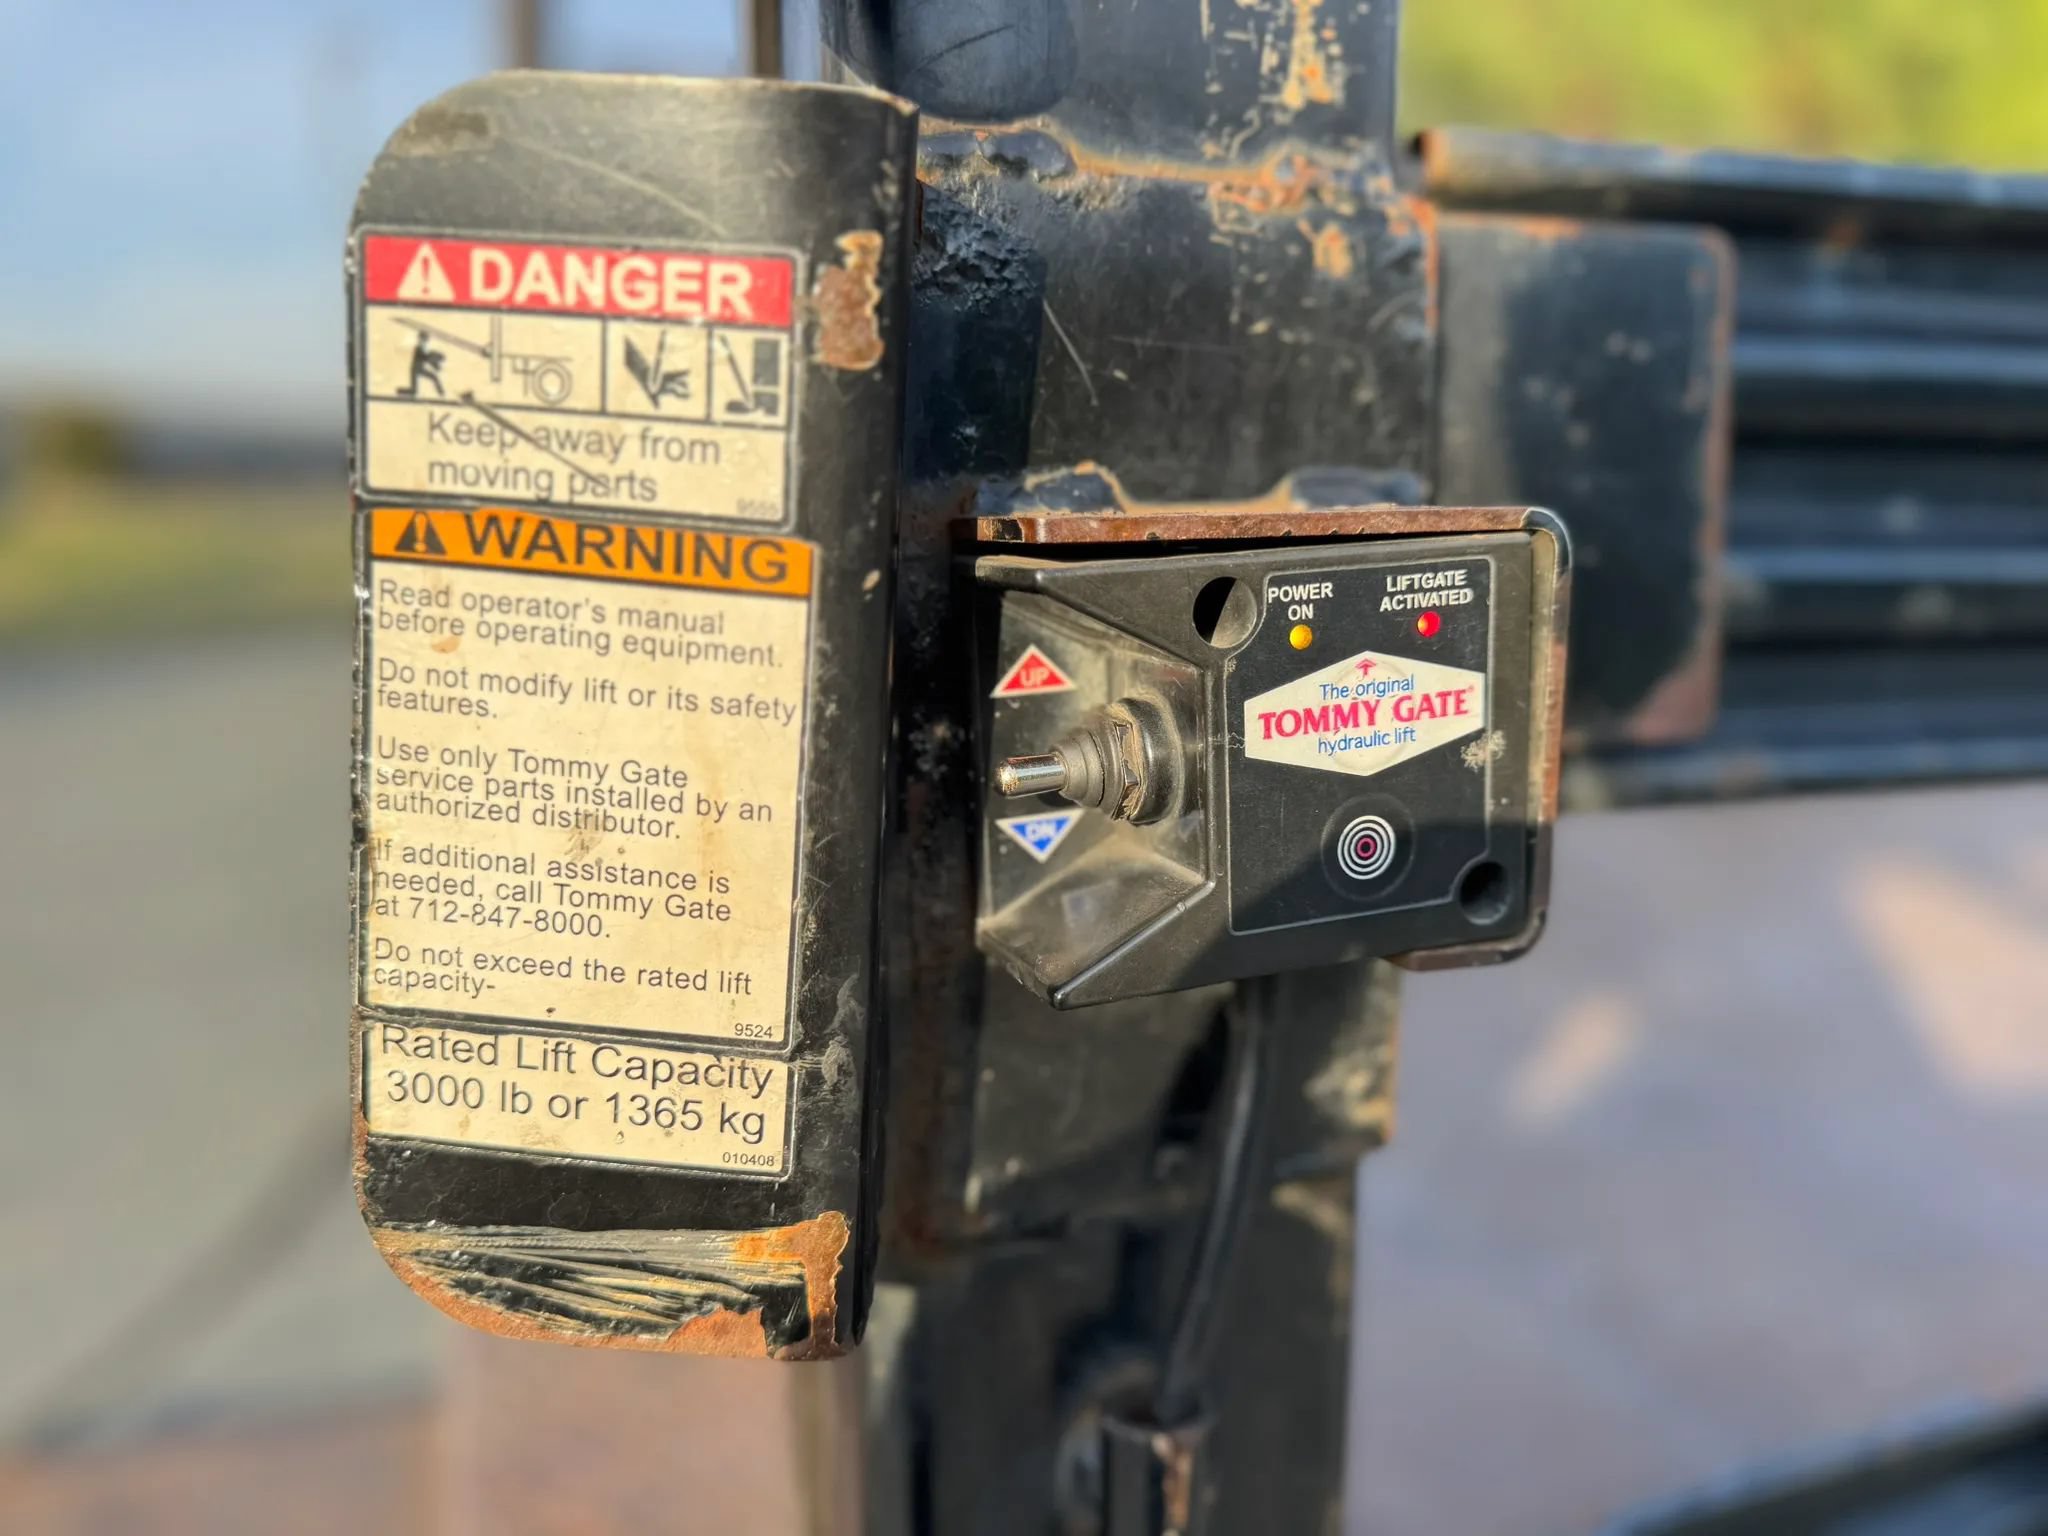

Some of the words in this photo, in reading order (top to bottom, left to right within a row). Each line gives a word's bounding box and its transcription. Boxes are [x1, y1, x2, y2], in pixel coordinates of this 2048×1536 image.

[470, 248, 754, 318] DANGER
[429, 412, 518, 454] Keep
[534, 427, 626, 463] away
[640, 429, 721, 464] from
[429, 459, 554, 500] moving
[569, 472, 658, 503] parts
[463, 511, 788, 584] WARNING
[1267, 581, 1334, 604] POWER
[1379, 587, 1474, 612] ACTIVATED
[1385, 569, 1469, 593] LIFTGATE
[380, 579, 450, 609] Read
[462, 592, 607, 625] operator's
[618, 606, 725, 635] manual
[1288, 603, 1315, 621] ON
[379, 608, 465, 636] before
[476, 616, 611, 656] operating
[623, 633, 783, 669] equipment.
[379, 658, 415, 684] Do
[426, 666, 469, 689] not
[480, 669, 573, 706] modify
[585, 677, 618, 705] lift
[628, 686, 657, 709] or
[667, 686, 698, 712] its
[710, 695, 797, 727] safety
[1019, 666, 1050, 689] UP
[1319, 683, 1350, 701] The
[1355, 674, 1415, 699] original
[377, 685, 498, 719] features.
[1258, 698, 1381, 740] TOMMY
[377, 736, 429, 763] Use
[440, 745, 497, 775] only
[508, 748, 609, 786] Tommy
[621, 760, 688, 788] Gate
[1317, 730, 1391, 758] hydraulic
[1395, 726, 1417, 745] lift
[376, 768, 474, 794] service
[485, 775, 555, 801] parts
[567, 780, 684, 814] installed
[696, 792, 728, 823] by
[738, 802, 773, 823] an
[376, 791, 520, 824] authorized
[532, 803, 681, 839] distributor.
[1024, 820, 1057, 842] DN
[375, 837, 393, 861] If
[402, 843, 535, 875] additional
[547, 857, 697, 891] assistance
[709, 870, 731, 895] is
[375, 896, 399, 917] at
[410, 896, 611, 938] 712-847-8000.
[376, 870, 483, 901] needed,
[496, 880, 542, 903] call
[554, 882, 654, 919] Tommy
[665, 894, 731, 922] Gate
[374, 967, 496, 999] capacity-
[375, 937, 410, 962] Do
[422, 946, 463, 968] not
[473, 949, 572, 977] exceed
[584, 958, 626, 983] the
[637, 966, 708, 992] rated
[719, 969, 752, 995] lift
[734, 1022, 773, 1039] 9524
[382, 1023, 499, 1066] Rated
[517, 1036, 577, 1074] Lift
[592, 1044, 774, 1098] Capacity
[387, 1070, 485, 1109] 3000
[501, 1080, 533, 1115] lb
[548, 1092, 589, 1120] or
[605, 1091, 703, 1131] 1365
[720, 1102, 766, 1144] kg
[722, 1151, 775, 1167] 010408
